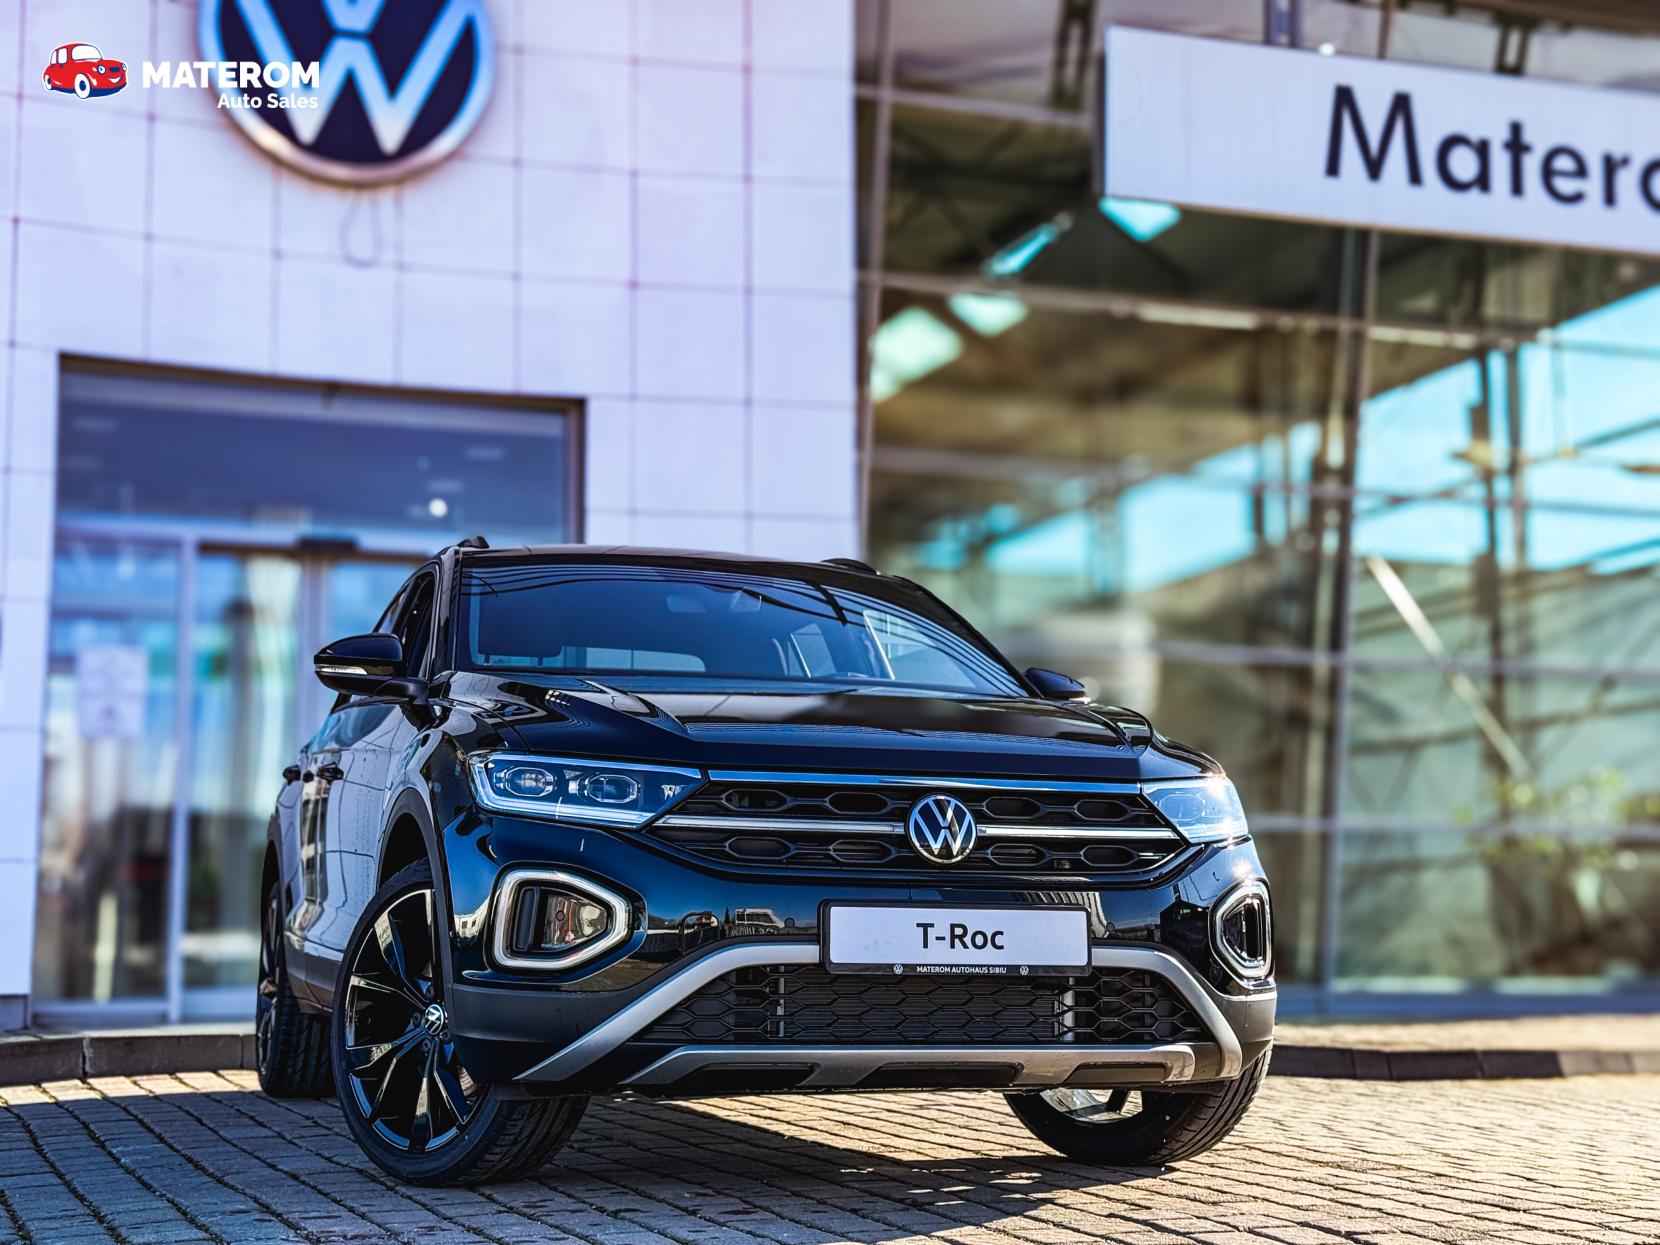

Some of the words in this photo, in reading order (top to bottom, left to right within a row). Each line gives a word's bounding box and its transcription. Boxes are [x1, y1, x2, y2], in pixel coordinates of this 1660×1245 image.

[916, 922, 1006, 950] T-Roc
[916, 966, 951, 974] MATEROM
[951, 966, 988, 974] AUTOHAUS
[989, 966, 1007, 974] SIBIU
